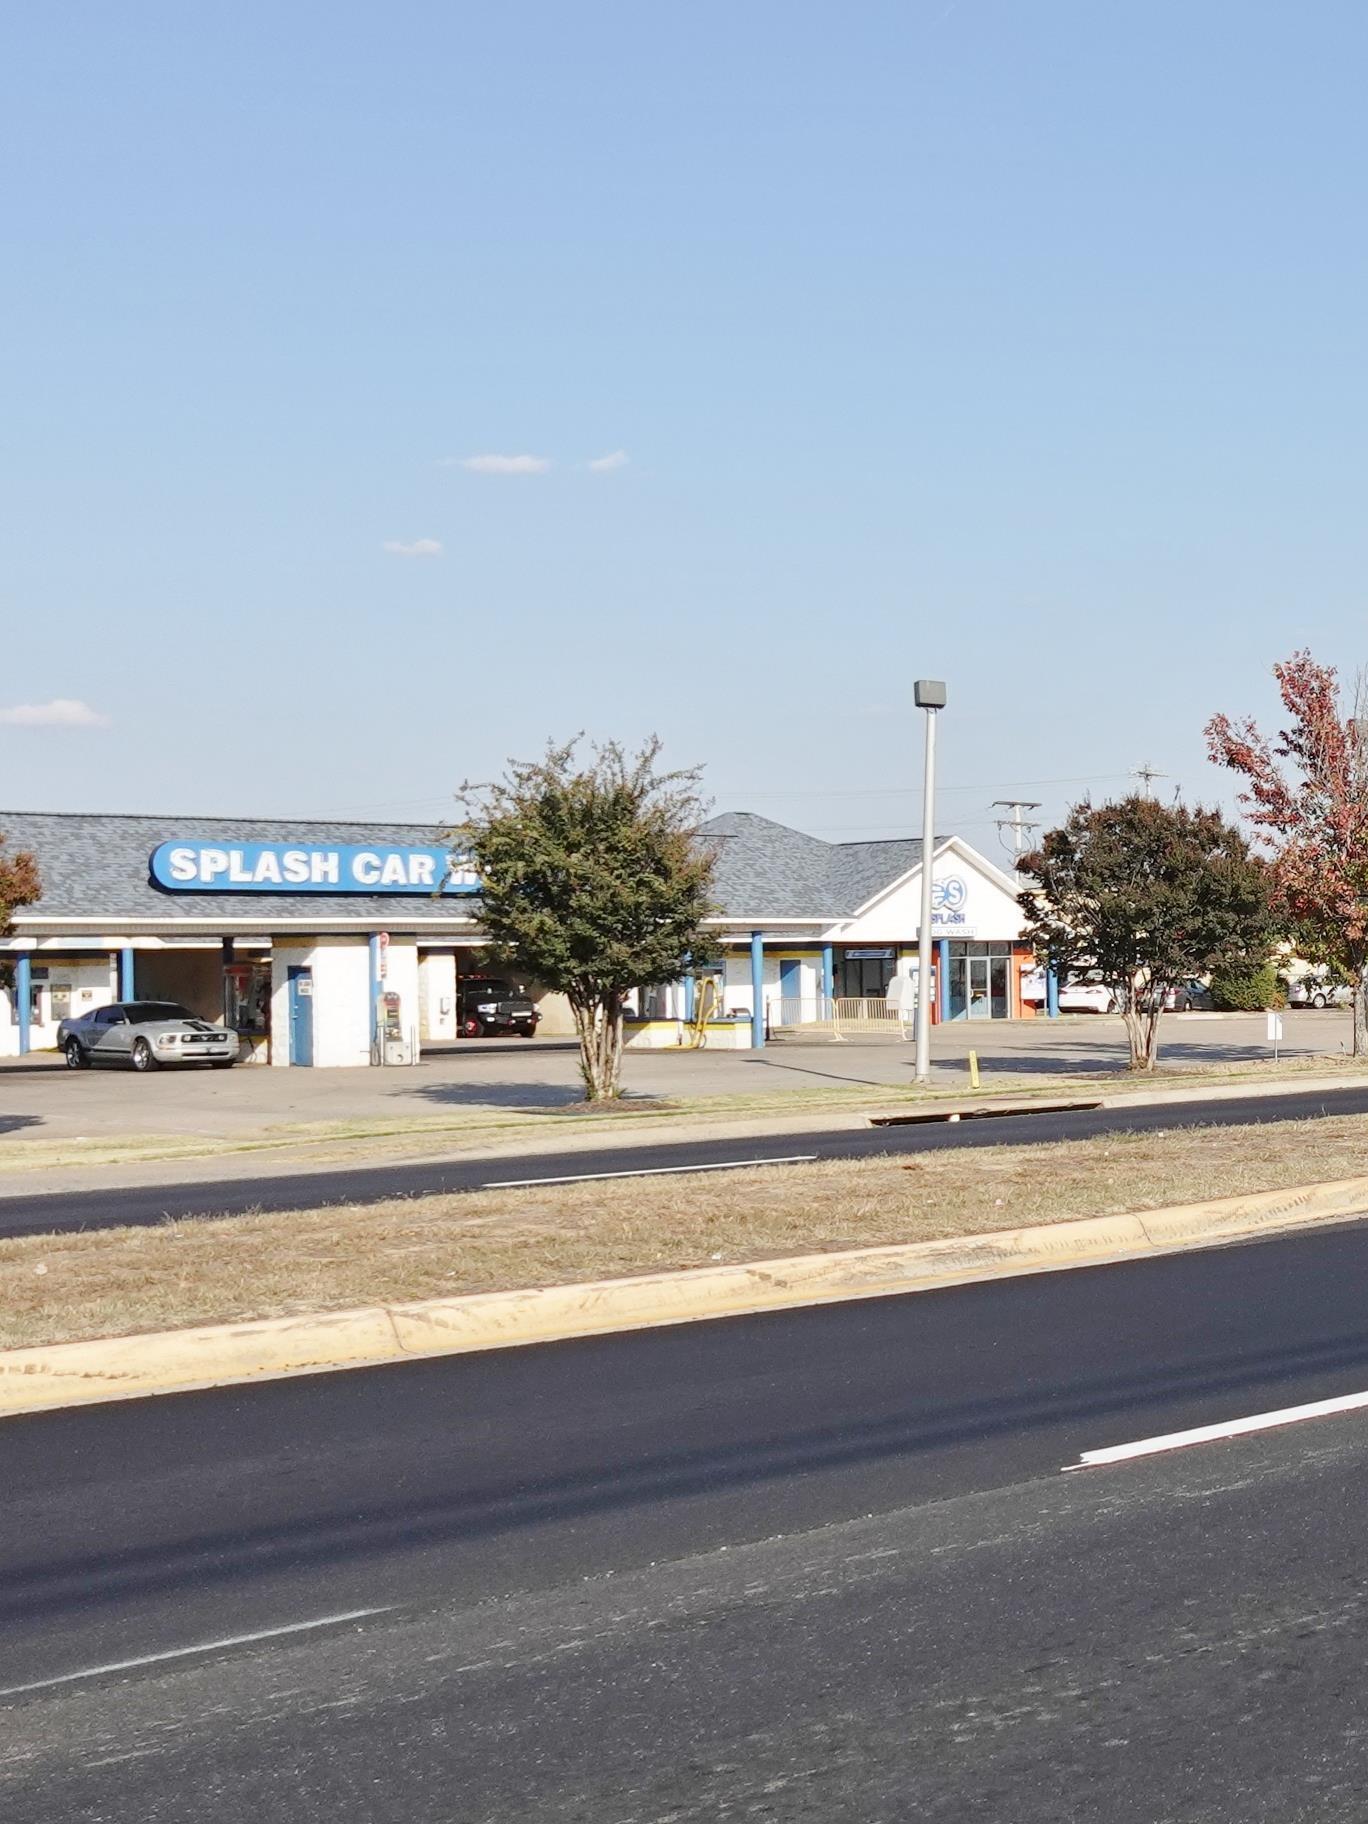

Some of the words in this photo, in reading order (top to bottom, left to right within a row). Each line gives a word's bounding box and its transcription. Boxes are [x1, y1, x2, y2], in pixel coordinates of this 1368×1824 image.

[169, 848, 339, 884] SPLASH
[352, 853, 436, 886] CAR
[930, 913, 965, 924] SPLASH
